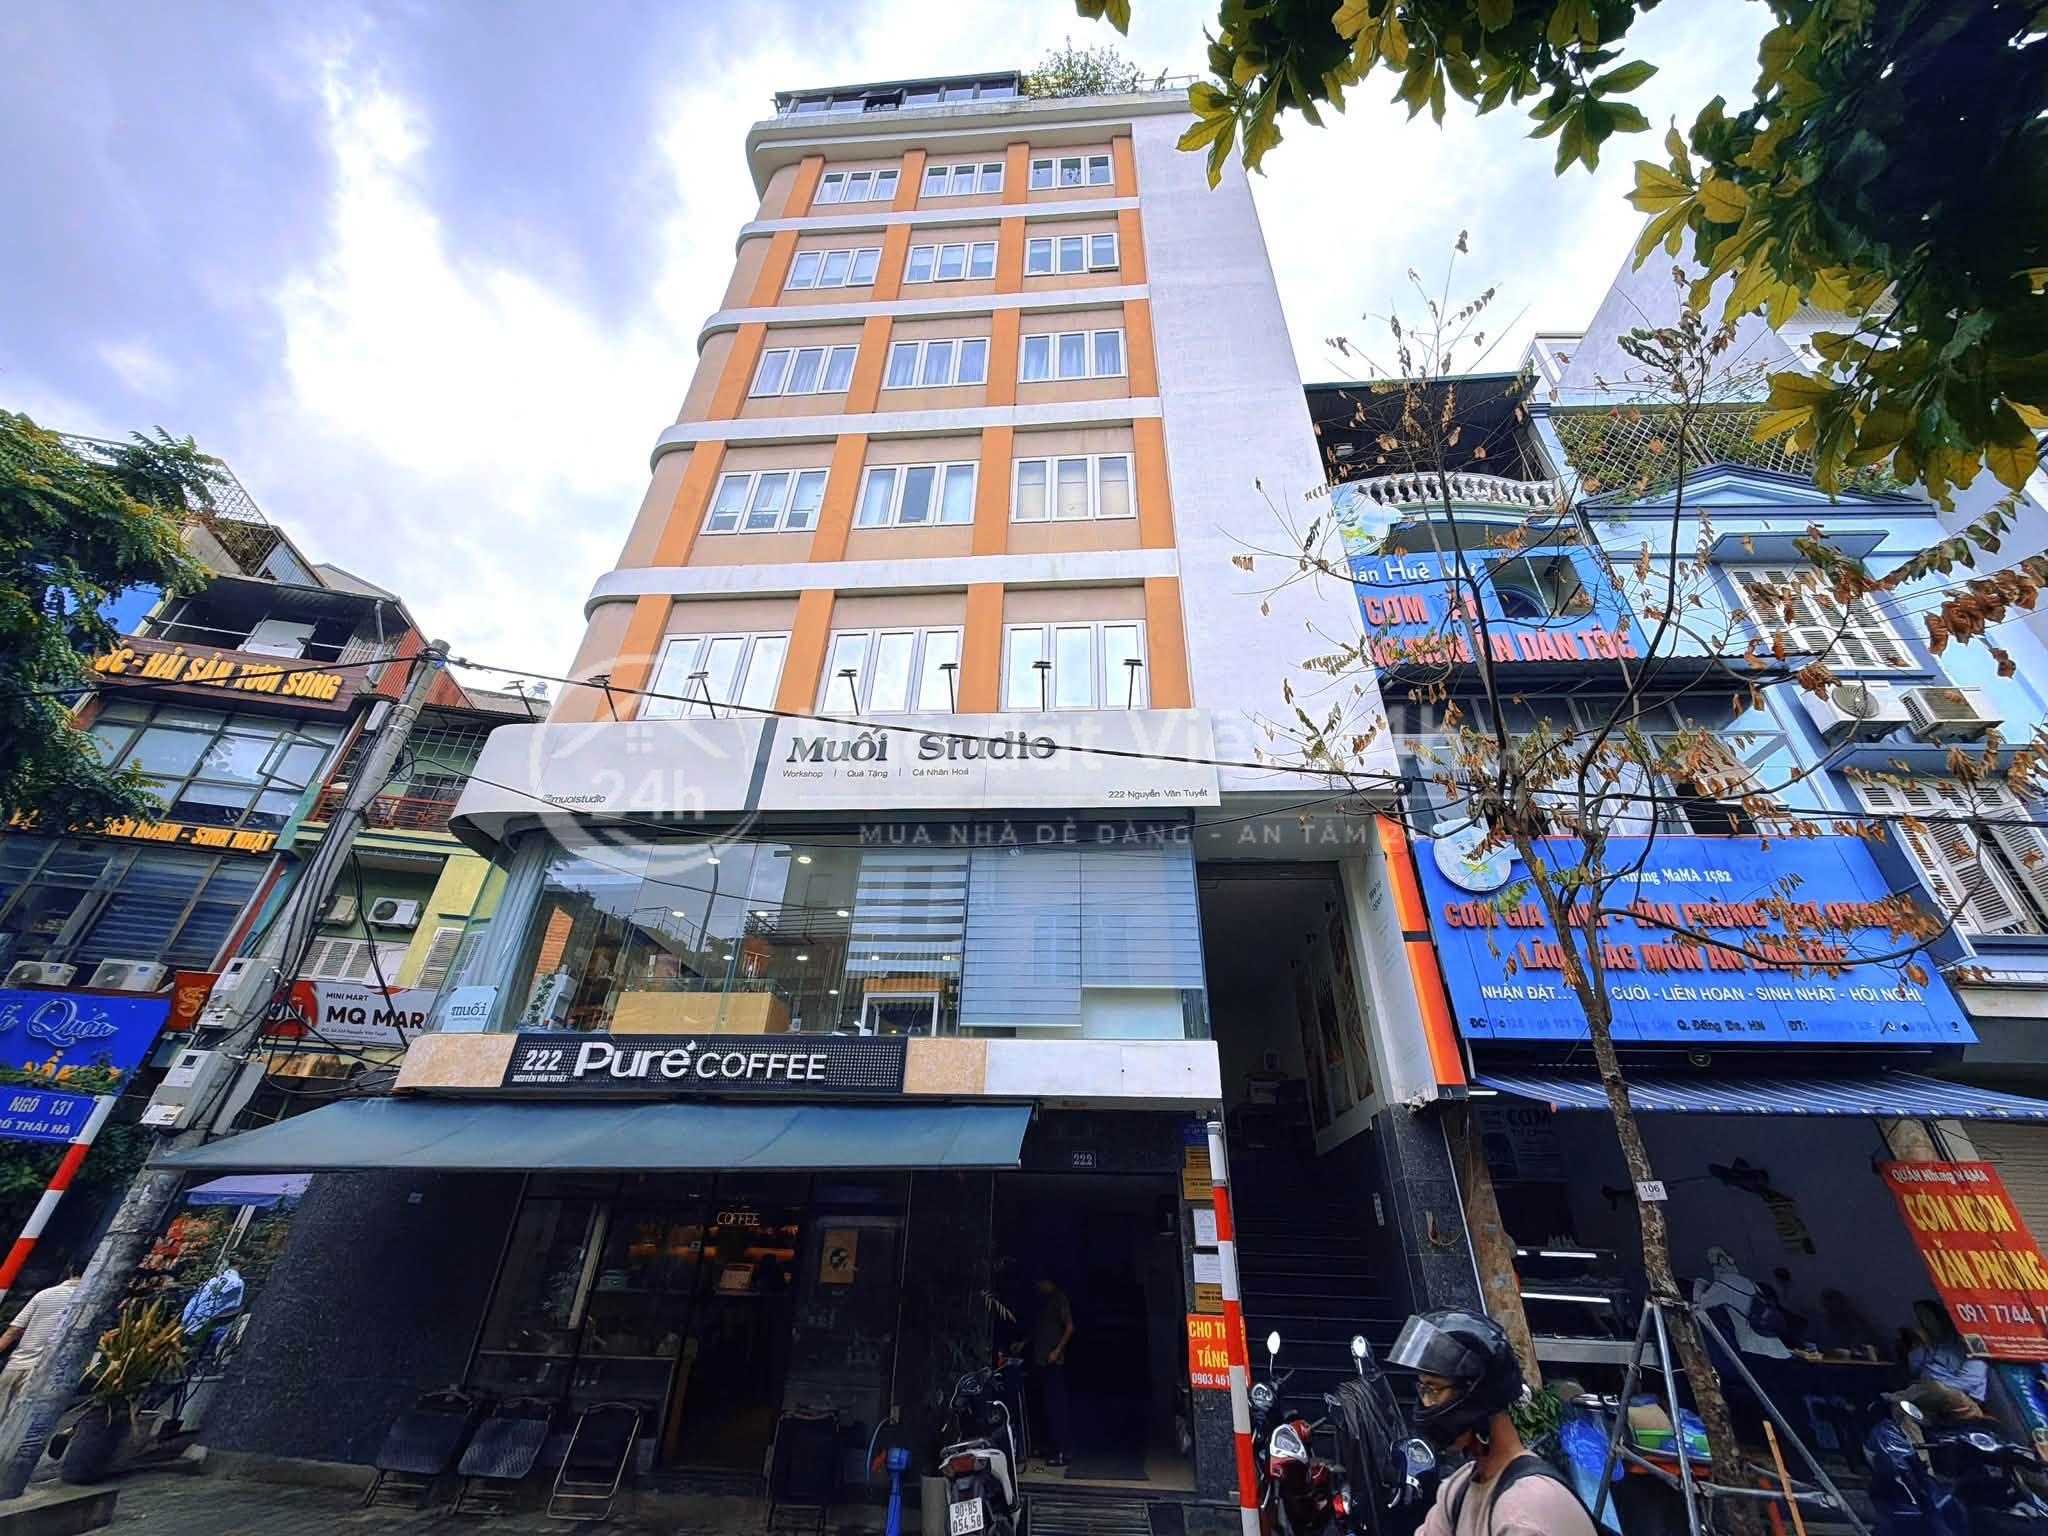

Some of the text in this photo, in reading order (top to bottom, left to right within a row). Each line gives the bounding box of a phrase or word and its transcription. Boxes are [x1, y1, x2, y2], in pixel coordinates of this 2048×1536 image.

[142, 647, 189, 680] HẢI
[786, 728, 888, 762] Muối
[918, 731, 1057, 760] Studio
[782, 769, 824, 779] Workshop
[867, 769, 889, 778] Tặng
[926, 768, 949, 777] Nhân
[1108, 788, 1208, 800] 222 Nguyễn Văn Tuyết
[1503, 904, 1546, 928] GIA
[325, 991, 345, 1000] MINI
[1481, 983, 1524, 1003] NHẬN
[1663, 984, 1698, 1001] LIÊN
[1700, 987, 1745, 1001] HOAN
[1756, 987, 1793, 1001] SINH
[1795, 986, 1836, 1005] NHẬT
[1850, 985, 1881, 1005] HỘI
[326, 1005, 367, 1025] MQ
[371, 1008, 430, 1030] MAR
[522, 1049, 563, 1071] 222
[697, 1051, 828, 1080] COFFEE
[49, 1099, 75, 1116] 131
[15, 1120, 49, 1133] THÁI
[50, 1122, 71, 1135] HÀ
[1073, 1152, 1093, 1166] 222
[1642, 1183, 1661, 1193] 106
[716, 1211, 761, 1226] COFFEE
[1947, 1194, 2017, 1232] NGON
[1923, 1239, 1980, 1289] VĂN
[1956, 1304, 1989, 1323] 091
[1189, 1321, 1212, 1339] CHO
[1191, 1373, 1213, 1385] 0903
